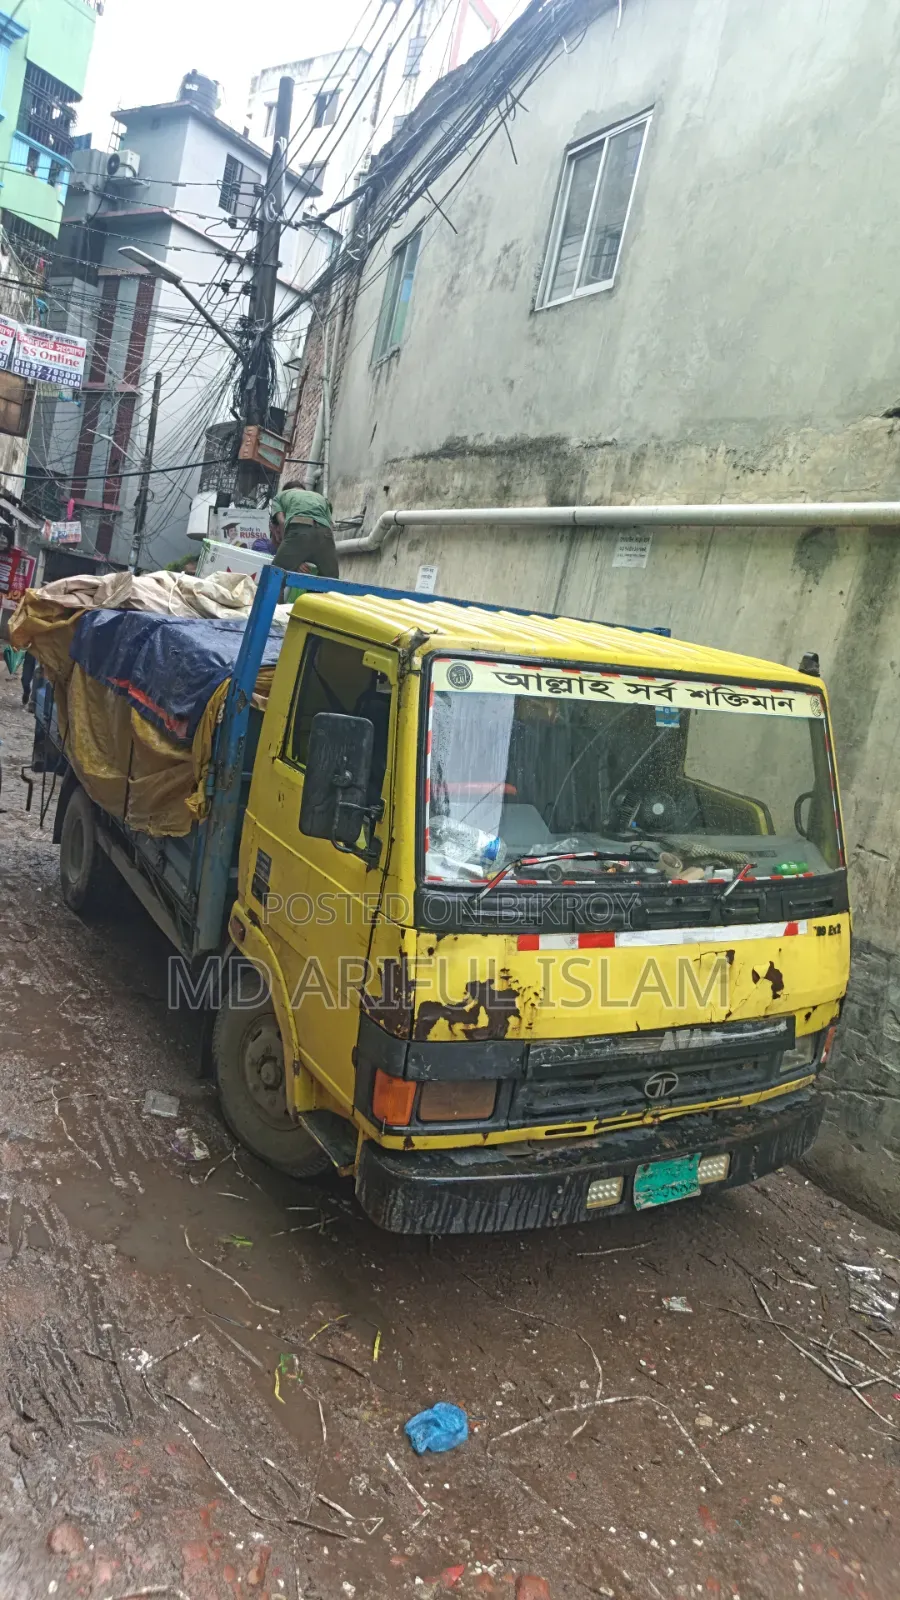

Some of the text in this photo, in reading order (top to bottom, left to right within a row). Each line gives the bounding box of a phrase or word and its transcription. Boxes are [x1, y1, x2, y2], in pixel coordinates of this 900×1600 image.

[23, 346, 37, 357] SS
[40, 350, 80, 367] Online
[56, 342, 84, 357] সংযোগ
[491, 671, 616, 699] আল্লাহ
[624, 681, 678, 702] সর্ব
[685, 686, 796, 712] শক্তিমান
